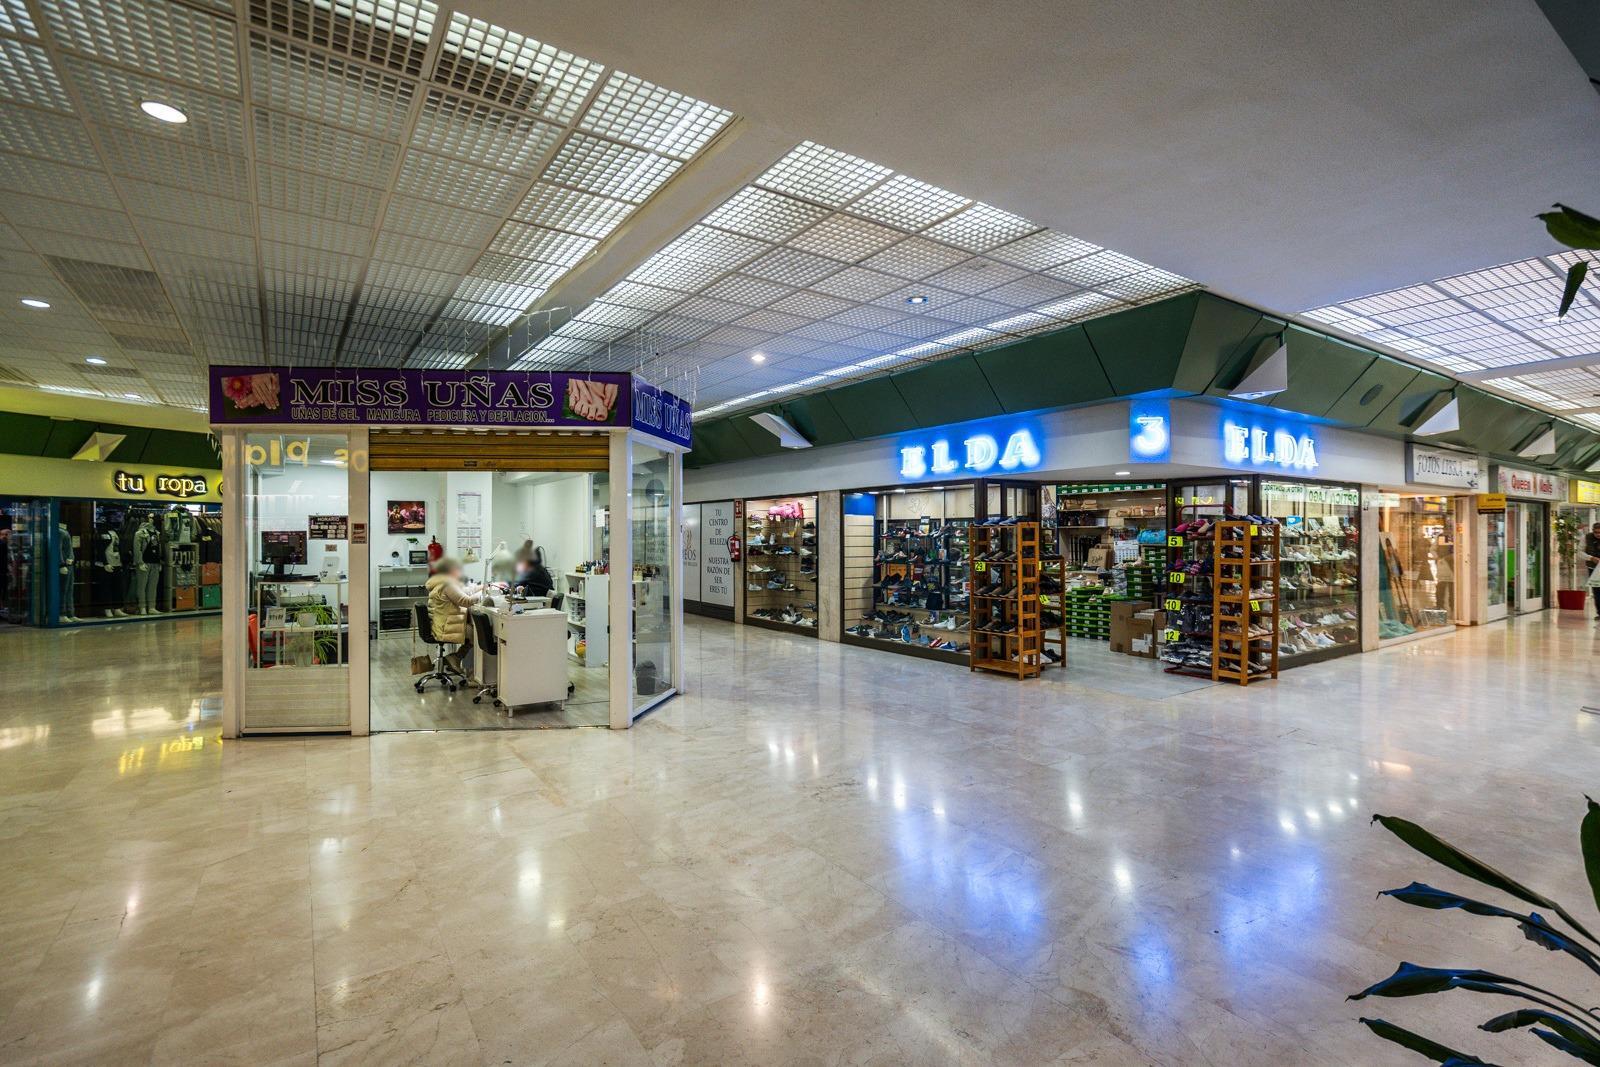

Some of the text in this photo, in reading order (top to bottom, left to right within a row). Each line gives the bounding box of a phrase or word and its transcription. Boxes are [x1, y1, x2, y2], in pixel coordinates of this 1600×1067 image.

[290, 375, 555, 408] MISS UÑAS
[291, 405, 320, 420] UÑAS
[322, 407, 338, 420] DE
[338, 407, 360, 420] GEL
[366, 408, 421, 421] MANICURA
[427, 408, 479, 422] PEDICURA
[479, 409, 488, 422] Y
[634, 387, 691, 441] MISS UÑAS
[1135, 415, 1166, 453] 3
[1224, 420, 1319, 471] ELDA
[900, 428, 1040, 478] ELDA
[1416, 454, 1441, 476] FOTOS
[117, 472, 144, 492] tu
[157, 477, 207, 497] ropa
[1511, 473, 1532, 491] Queen
[715, 509, 722, 517] TU
[709, 518, 728, 527] CENTRO
[715, 528, 722, 536] DE
[1170, 537, 1178, 546] 5
[708, 556, 730, 566] NUESTRA
[723, 567, 730, 575] DE
[1171, 573, 1181, 583] 10
[709, 585, 721, 594] ERES
[1166, 600, 1177, 610] 10
[1165, 631, 1175, 640] 12
